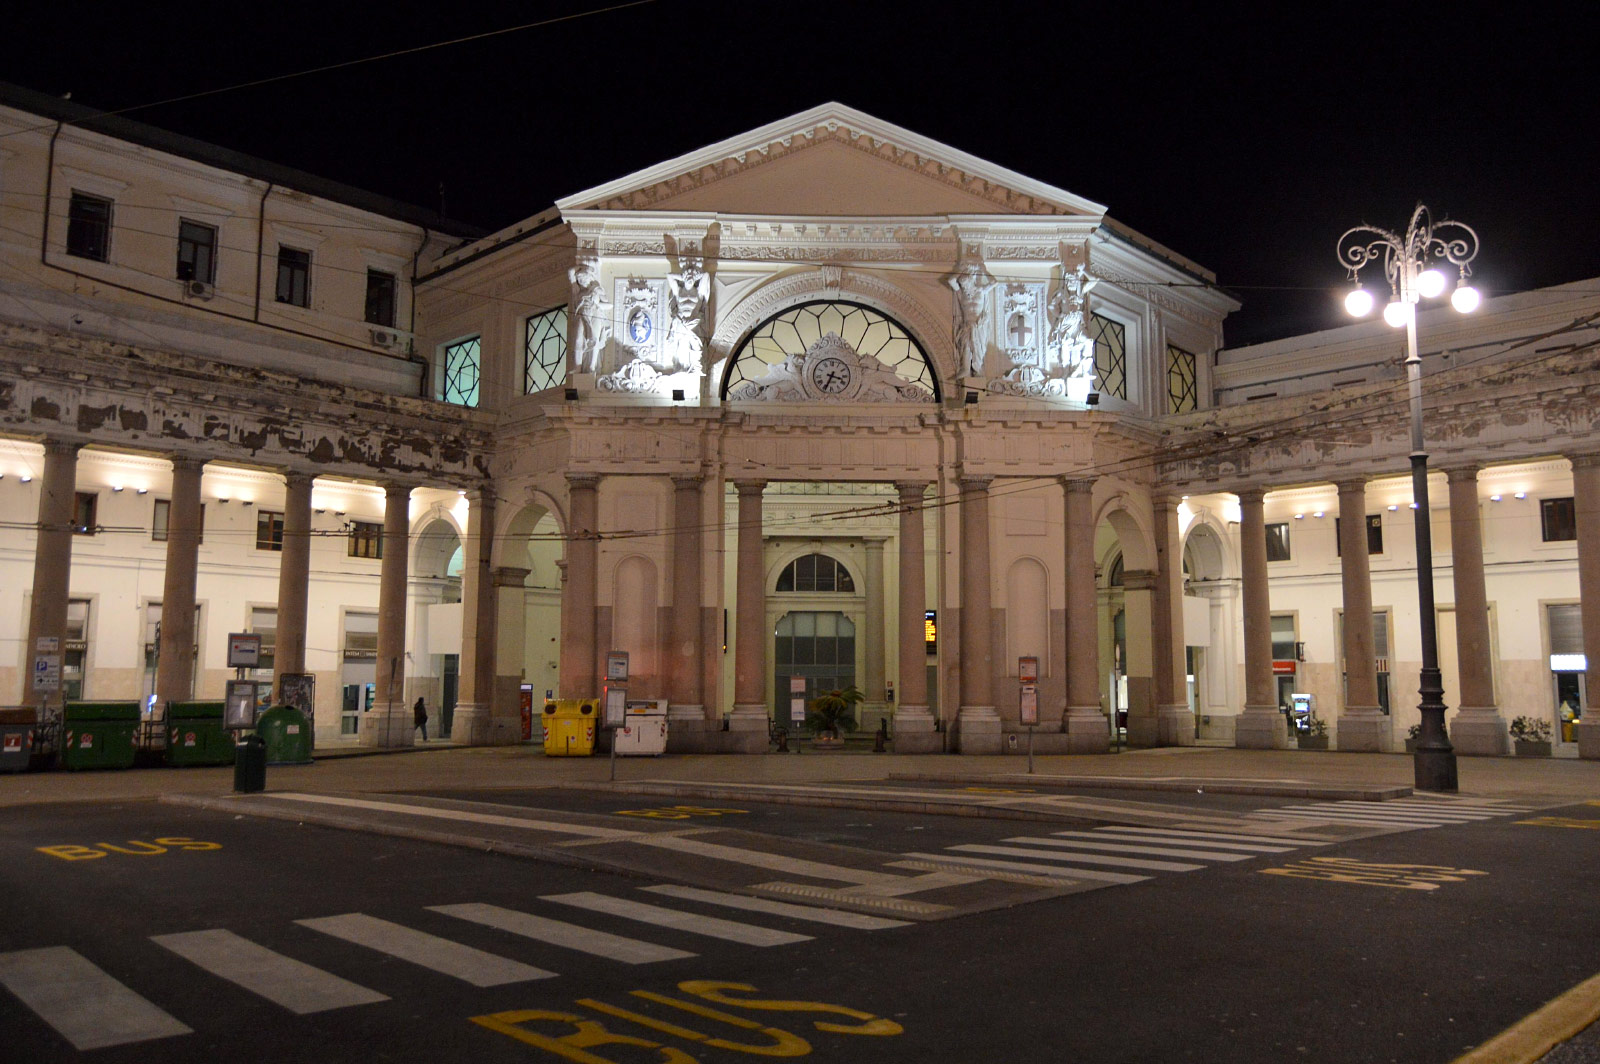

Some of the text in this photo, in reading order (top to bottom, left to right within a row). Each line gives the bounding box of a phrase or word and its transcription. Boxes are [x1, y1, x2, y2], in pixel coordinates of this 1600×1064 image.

[35, 837, 221, 861] BUS
[1256, 857, 1489, 890] BUS
[467, 979, 905, 1064] BUS
